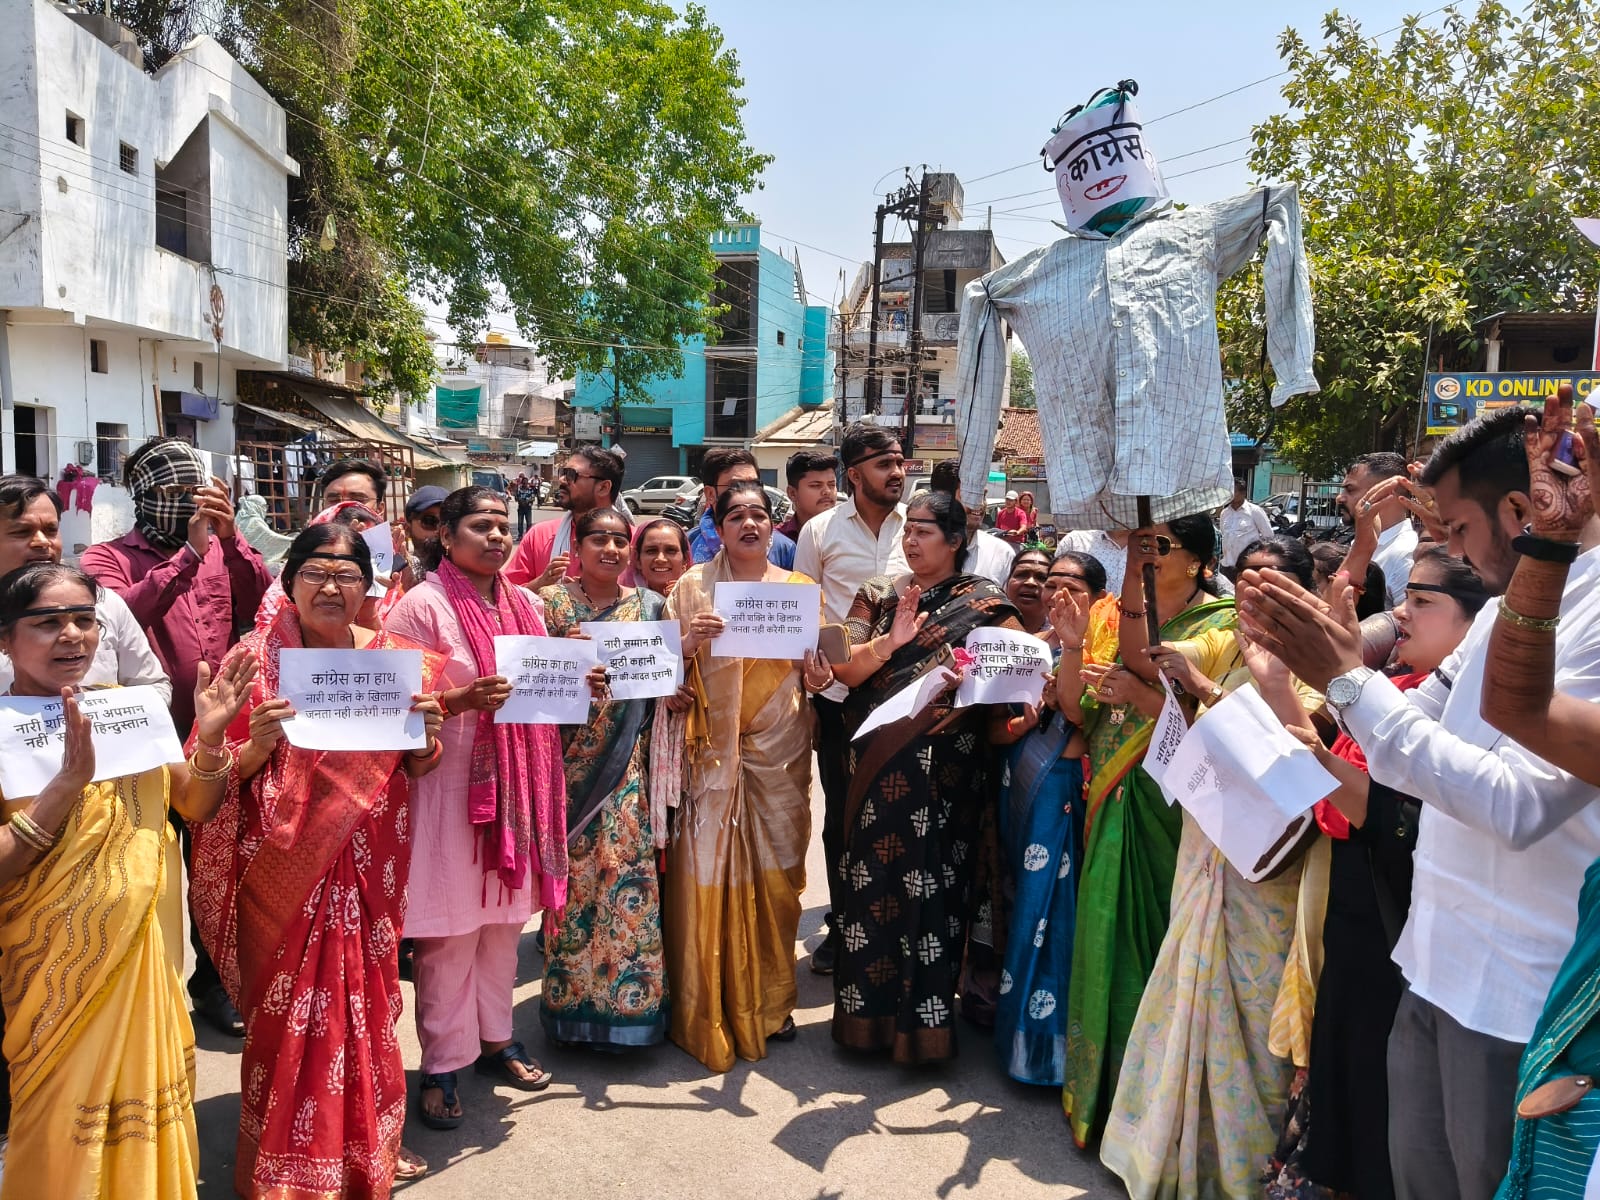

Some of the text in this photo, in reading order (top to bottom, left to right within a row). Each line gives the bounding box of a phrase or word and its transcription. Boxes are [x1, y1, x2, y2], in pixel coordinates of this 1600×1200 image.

[1067, 131, 1144, 181] कांग्रेस
[1466, 379, 1493, 396] KD
[735, 597, 799, 610] कांग्रेस का हाथ
[731, 612, 745, 622] नारी
[767, 612, 775, 621] के
[731, 626, 750, 634] जनता
[752, 624, 765, 634] नही
[766, 624, 785, 634] करेगी
[604, 636, 663, 649] नारी सम्मान की
[1009, 640, 1021, 653] के
[521, 655, 578, 671] कांग्रेस का हाथ
[609, 655, 656, 670] झूठी कहानी
[979, 654, 1008, 664] सवाल
[1012, 654, 1042, 667] कांग्रेस
[311, 669, 396, 686] कांग्रेस का हाथ
[620, 672, 629, 681] की
[630, 672, 650, 680] आदत
[651, 668, 673, 680] पुरानी
[970, 664, 1034, 678] की पुरानी चाल
[518, 673, 530, 684] नारी
[550, 674, 558, 684] के
[305, 690, 401, 703] नारी शक्ति के खिलाफ
[516, 688, 533, 697] जनता
[547, 687, 564, 698] करेगी
[305, 710, 331, 720] जनता
[334, 706, 351, 719] नही
[353, 705, 378, 717] करेगी
[13, 719, 41, 735] नारी
[102, 705, 145, 719] अपमान
[24, 732, 49, 748] नहीं
[93, 717, 149, 735] हिन्दुस्तान
